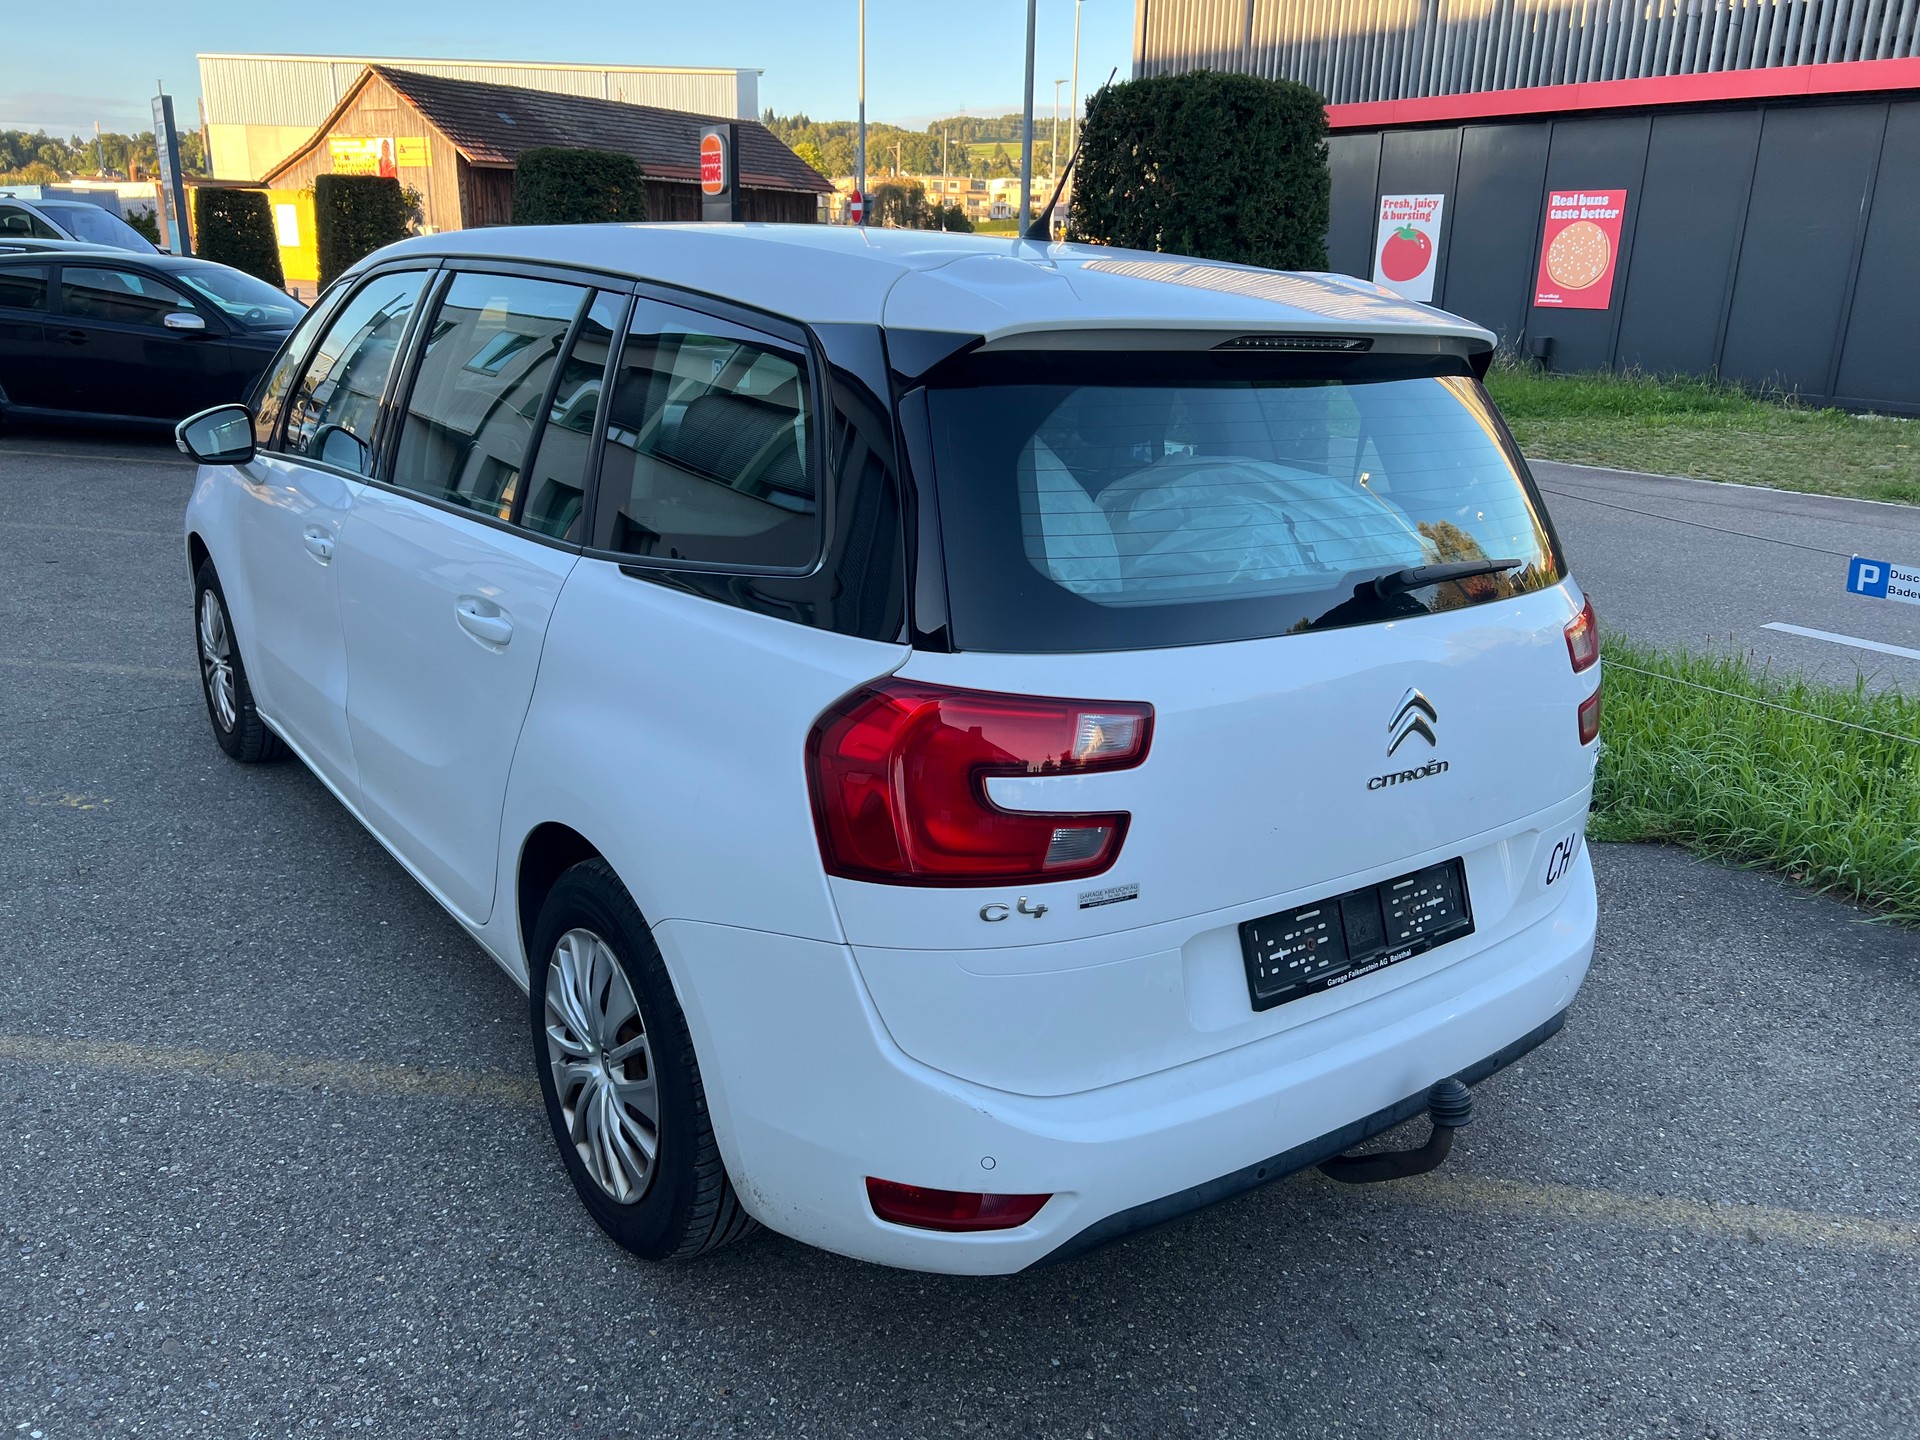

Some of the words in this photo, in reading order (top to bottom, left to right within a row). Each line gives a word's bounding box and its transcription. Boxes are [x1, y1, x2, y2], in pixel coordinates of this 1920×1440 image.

[701, 165, 721, 182] KING
[1383, 199, 1412, 210] Fresh,
[1413, 198, 1439, 211] juicy
[1552, 194, 1578, 206] Real
[1579, 194, 1609, 206] buns
[1382, 211, 1390, 220] &
[1390, 210, 1432, 222] bursting
[1550, 208, 1580, 219] taste
[1580, 207, 1619, 219] better
[1857, 563, 1880, 592] P
[1546, 832, 1576, 885] CH
[979, 896, 1049, 922] C4
[1327, 974, 1348, 987] Garage
[1348, 962, 1379, 979] Falkenstein
[1379, 957, 1388, 967] AG
[1390, 949, 1412, 963] Balsthal
